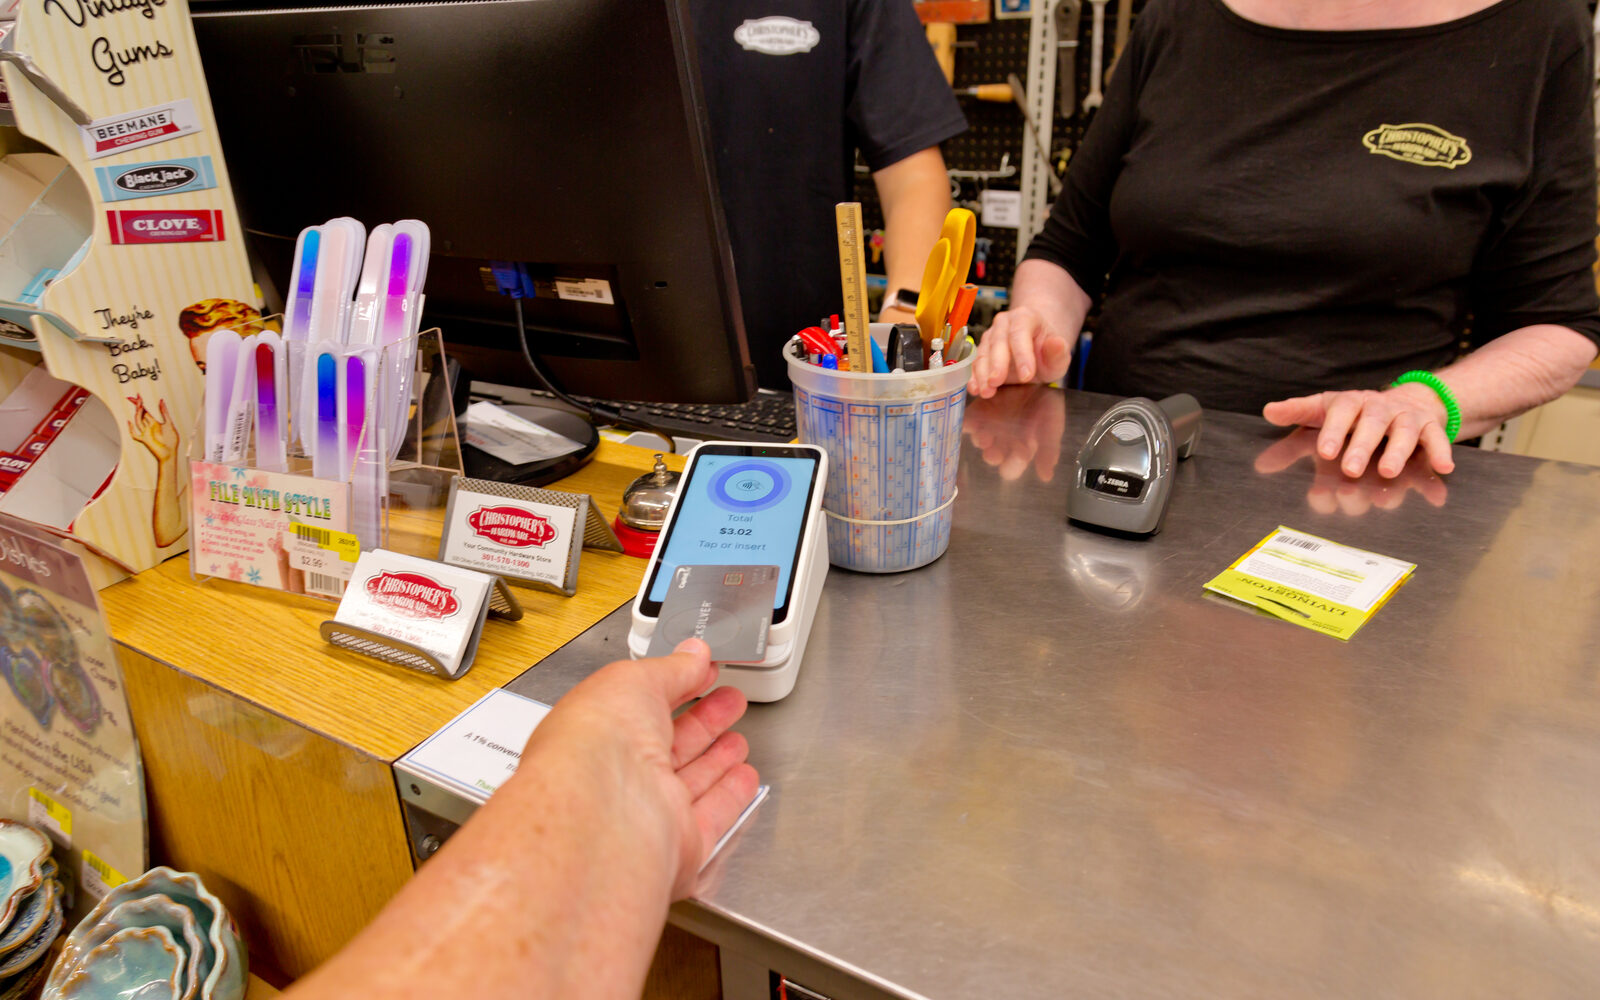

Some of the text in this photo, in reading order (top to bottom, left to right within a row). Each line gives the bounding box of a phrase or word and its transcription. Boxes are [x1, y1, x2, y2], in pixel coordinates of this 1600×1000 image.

[91, 36, 173, 86] Gums
[96, 113, 167, 140] BEEMANS
[114, 127, 164, 146] CHEWING GUM
[124, 168, 188, 188] Black Jack
[132, 217, 200, 231] CLOVE
[93, 304, 154, 330] They're
[112, 358, 162, 384] Baby!
[1106, 477, 1129, 488] ZEBRA
[479, 510, 546, 538] CHRISTOPHER'S
[727, 514, 753, 523] Total
[719, 526, 753, 537] $3.02
[699, 540, 767, 551] Tap or insert
[377, 575, 450, 610] CHRISTOPHER'S
[1241, 577, 1348, 617] LIVINGSTON
[463, 732, 473, 740] A
[473, 734, 487, 745] 1%
